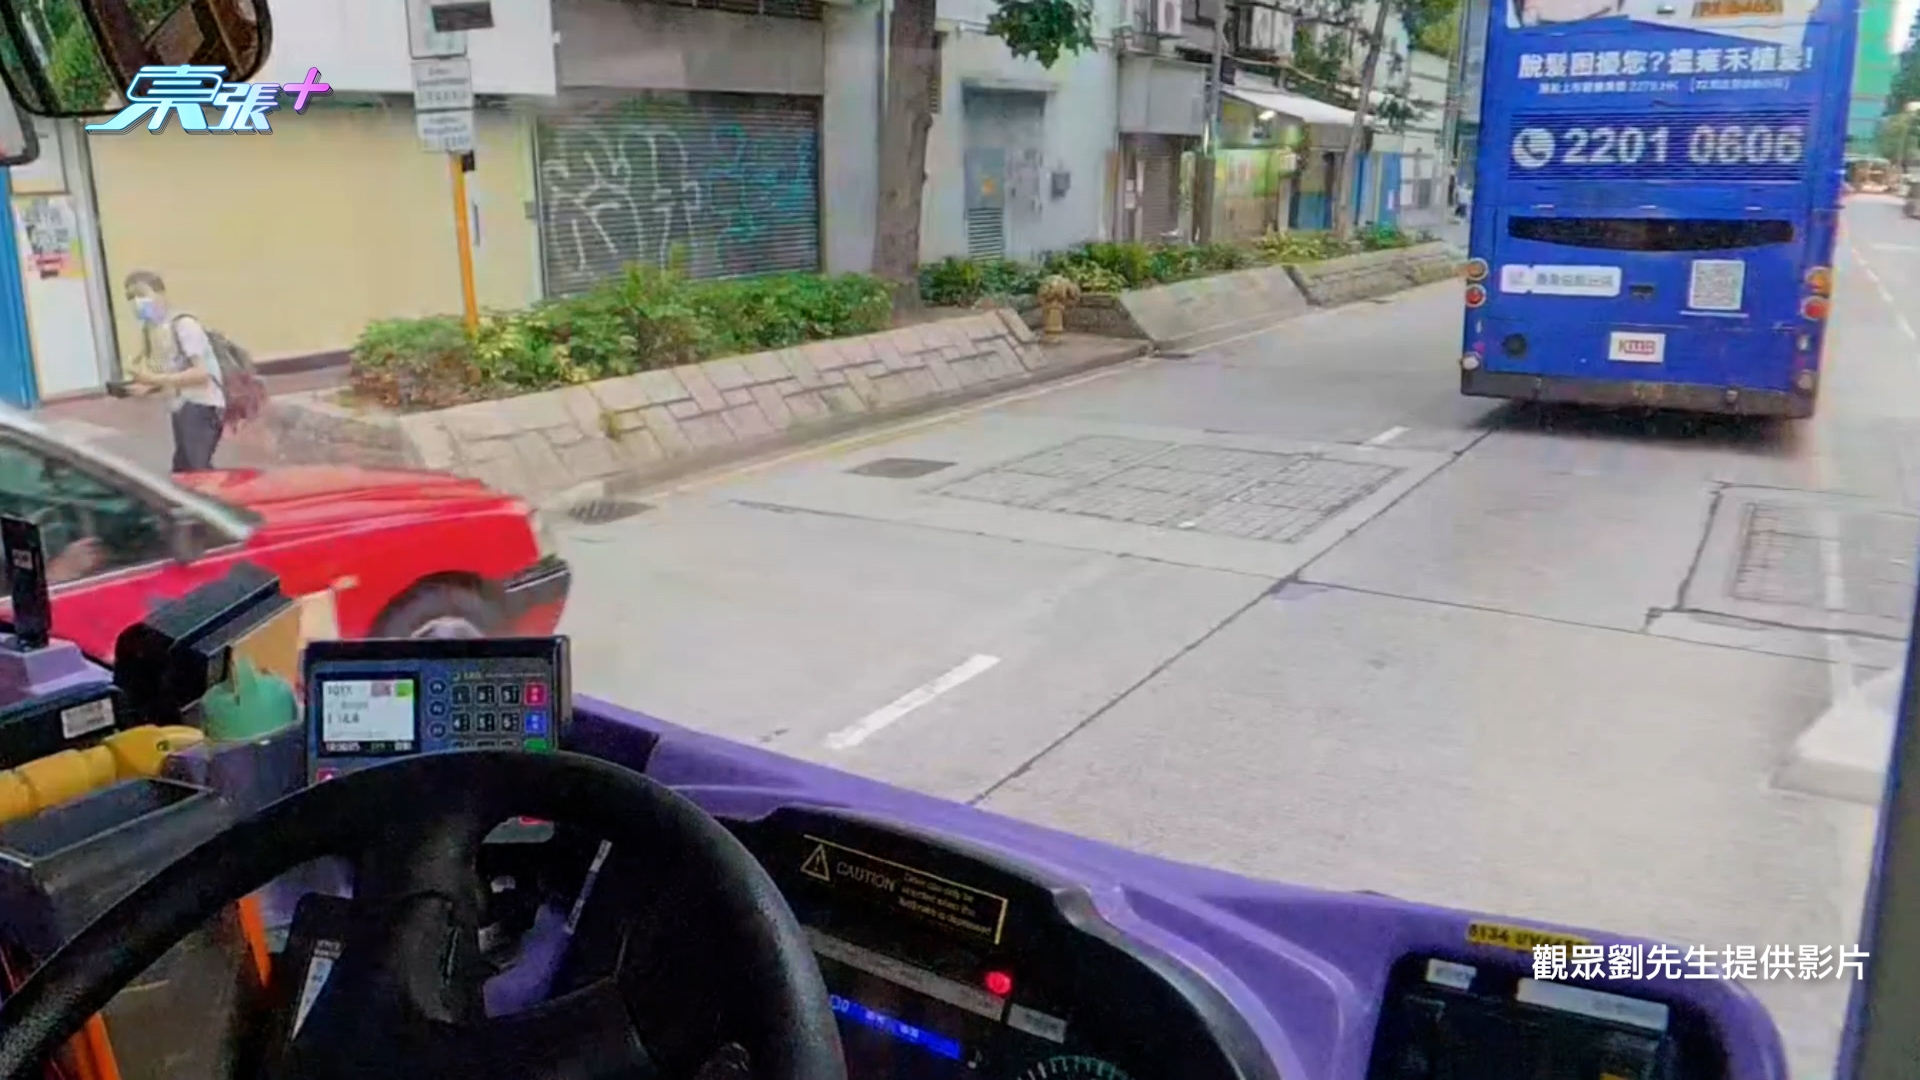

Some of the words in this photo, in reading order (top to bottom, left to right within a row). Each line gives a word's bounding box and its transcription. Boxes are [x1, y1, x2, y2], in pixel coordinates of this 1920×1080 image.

[1561, 126, 1670, 164] 2201
[1688, 124, 1803, 165] 0606
[836, 860, 895, 893] CAUTION
